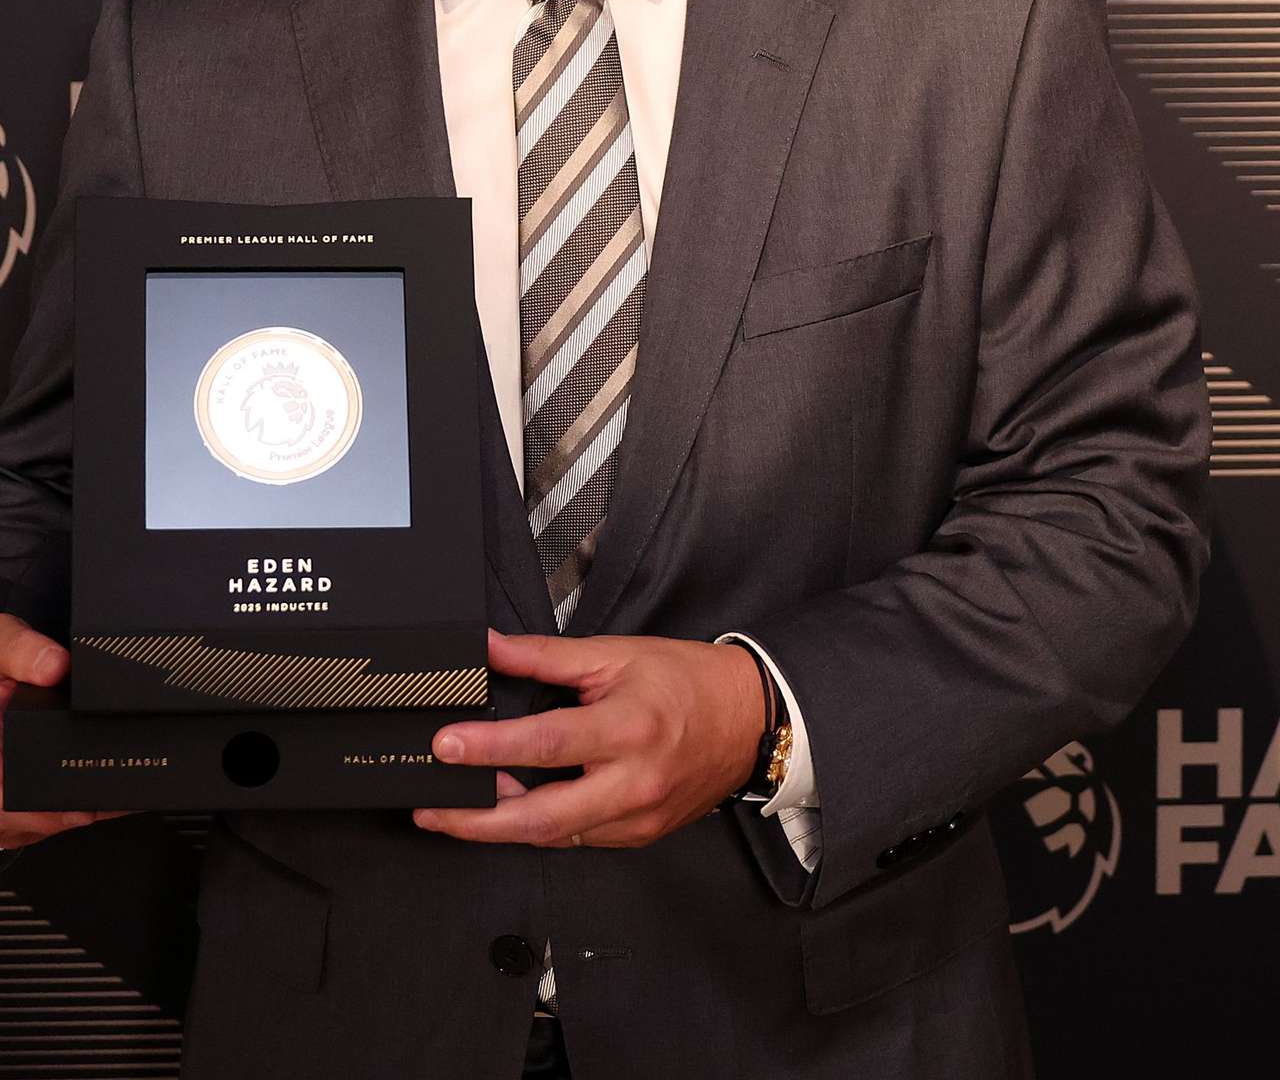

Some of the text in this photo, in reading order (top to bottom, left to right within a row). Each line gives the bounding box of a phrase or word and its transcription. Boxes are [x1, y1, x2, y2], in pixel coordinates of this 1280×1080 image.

[180, 233, 374, 245] PREMIER LEAGUE HALL OF FAME
[247, 558, 312, 573] EDEN
[229, 577, 332, 593] HAZARD
[233, 602, 329, 613] 2025 INDUCTEE
[61, 757, 168, 768] PREMIER LEAGUE
[344, 754, 433, 764] HALL OF FAME
